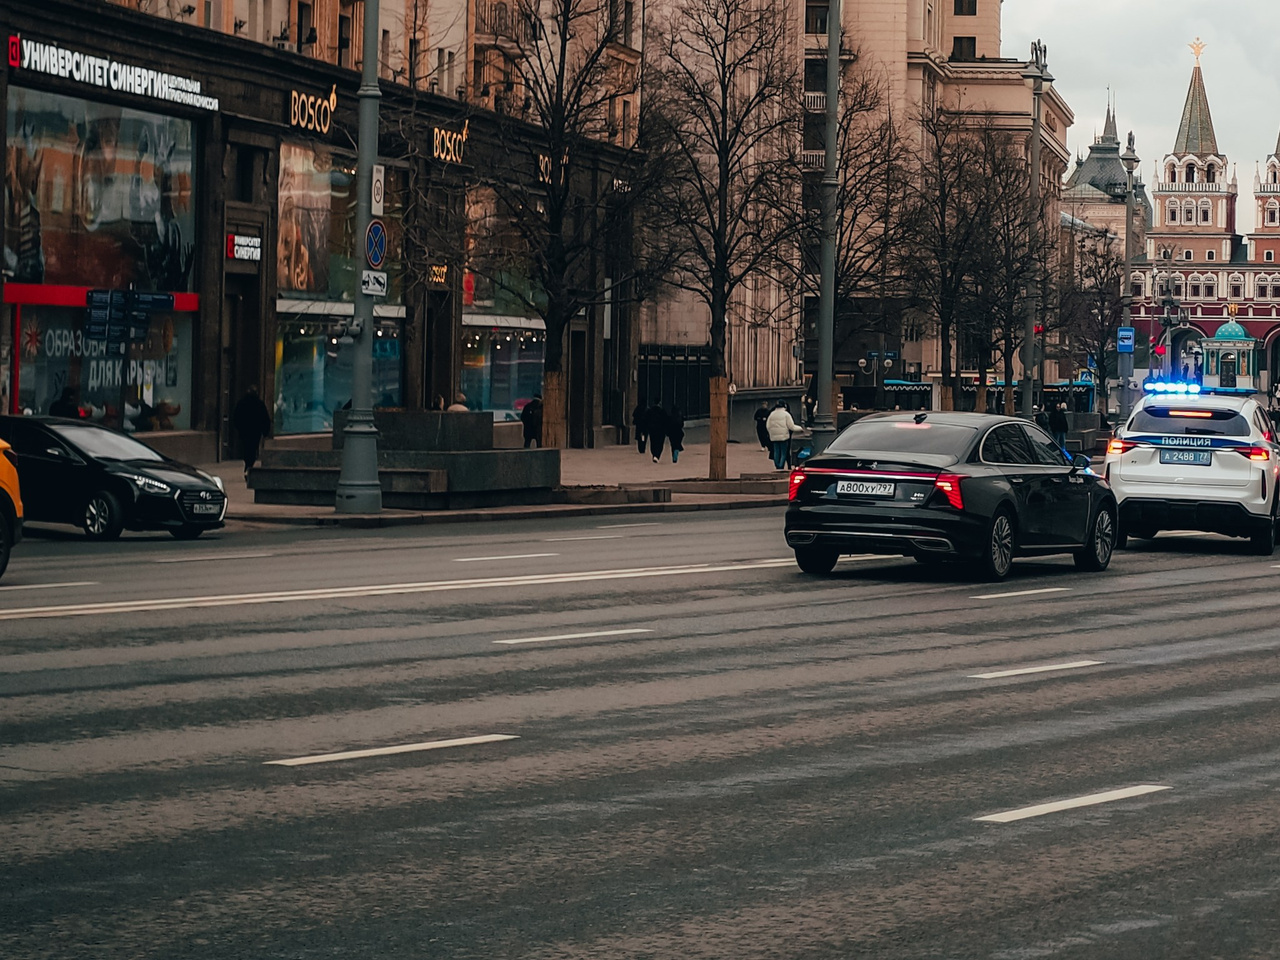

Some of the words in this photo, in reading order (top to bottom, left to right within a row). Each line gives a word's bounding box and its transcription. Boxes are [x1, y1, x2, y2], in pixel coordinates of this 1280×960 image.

[22, 39, 110, 87] УНИВЕРСИТЕТ
[109, 61, 169, 100] СИНЕРГИЯ
[291, 89, 331, 135] BOSCO
[433, 127, 464, 164] BOSCO
[88, 360, 112, 392] ДЛЯ
[114, 359, 166, 387] КРЬЕРЫ
[1161, 436, 1212, 446] ПОЛИЦИЯ
[1173, 452, 1195, 461] 2488
